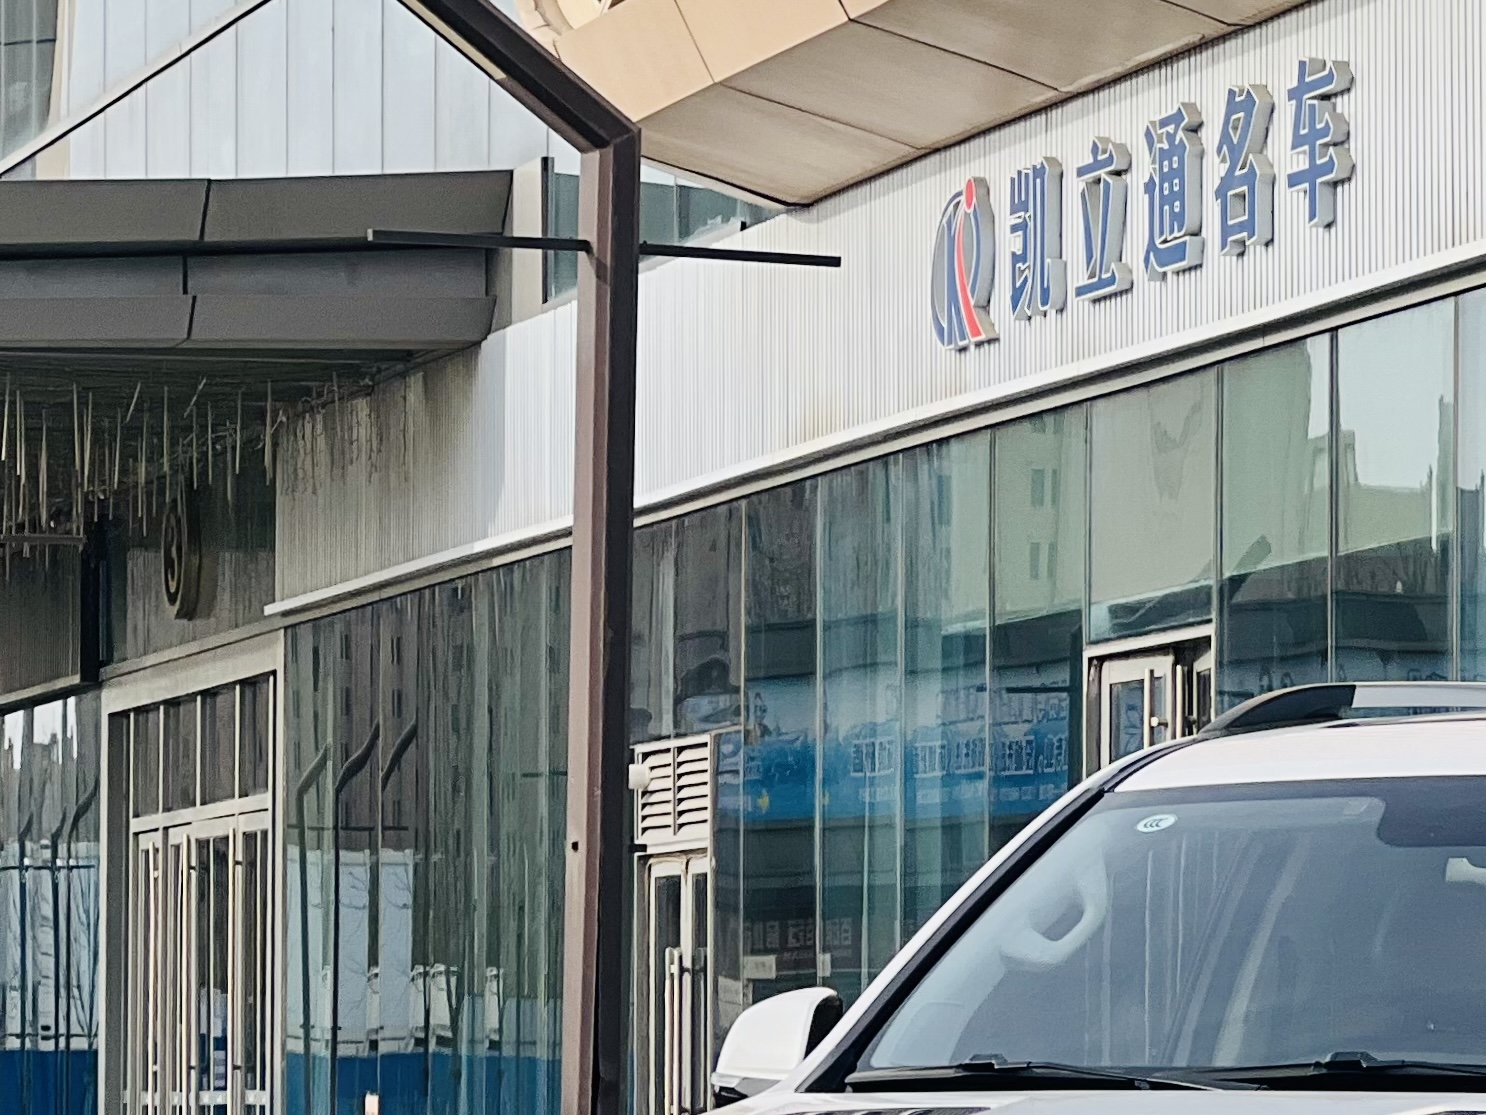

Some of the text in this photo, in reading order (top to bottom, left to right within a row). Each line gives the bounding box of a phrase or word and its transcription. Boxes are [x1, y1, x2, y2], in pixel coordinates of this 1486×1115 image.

[1009, 57, 1354, 321] 凯立通名车
